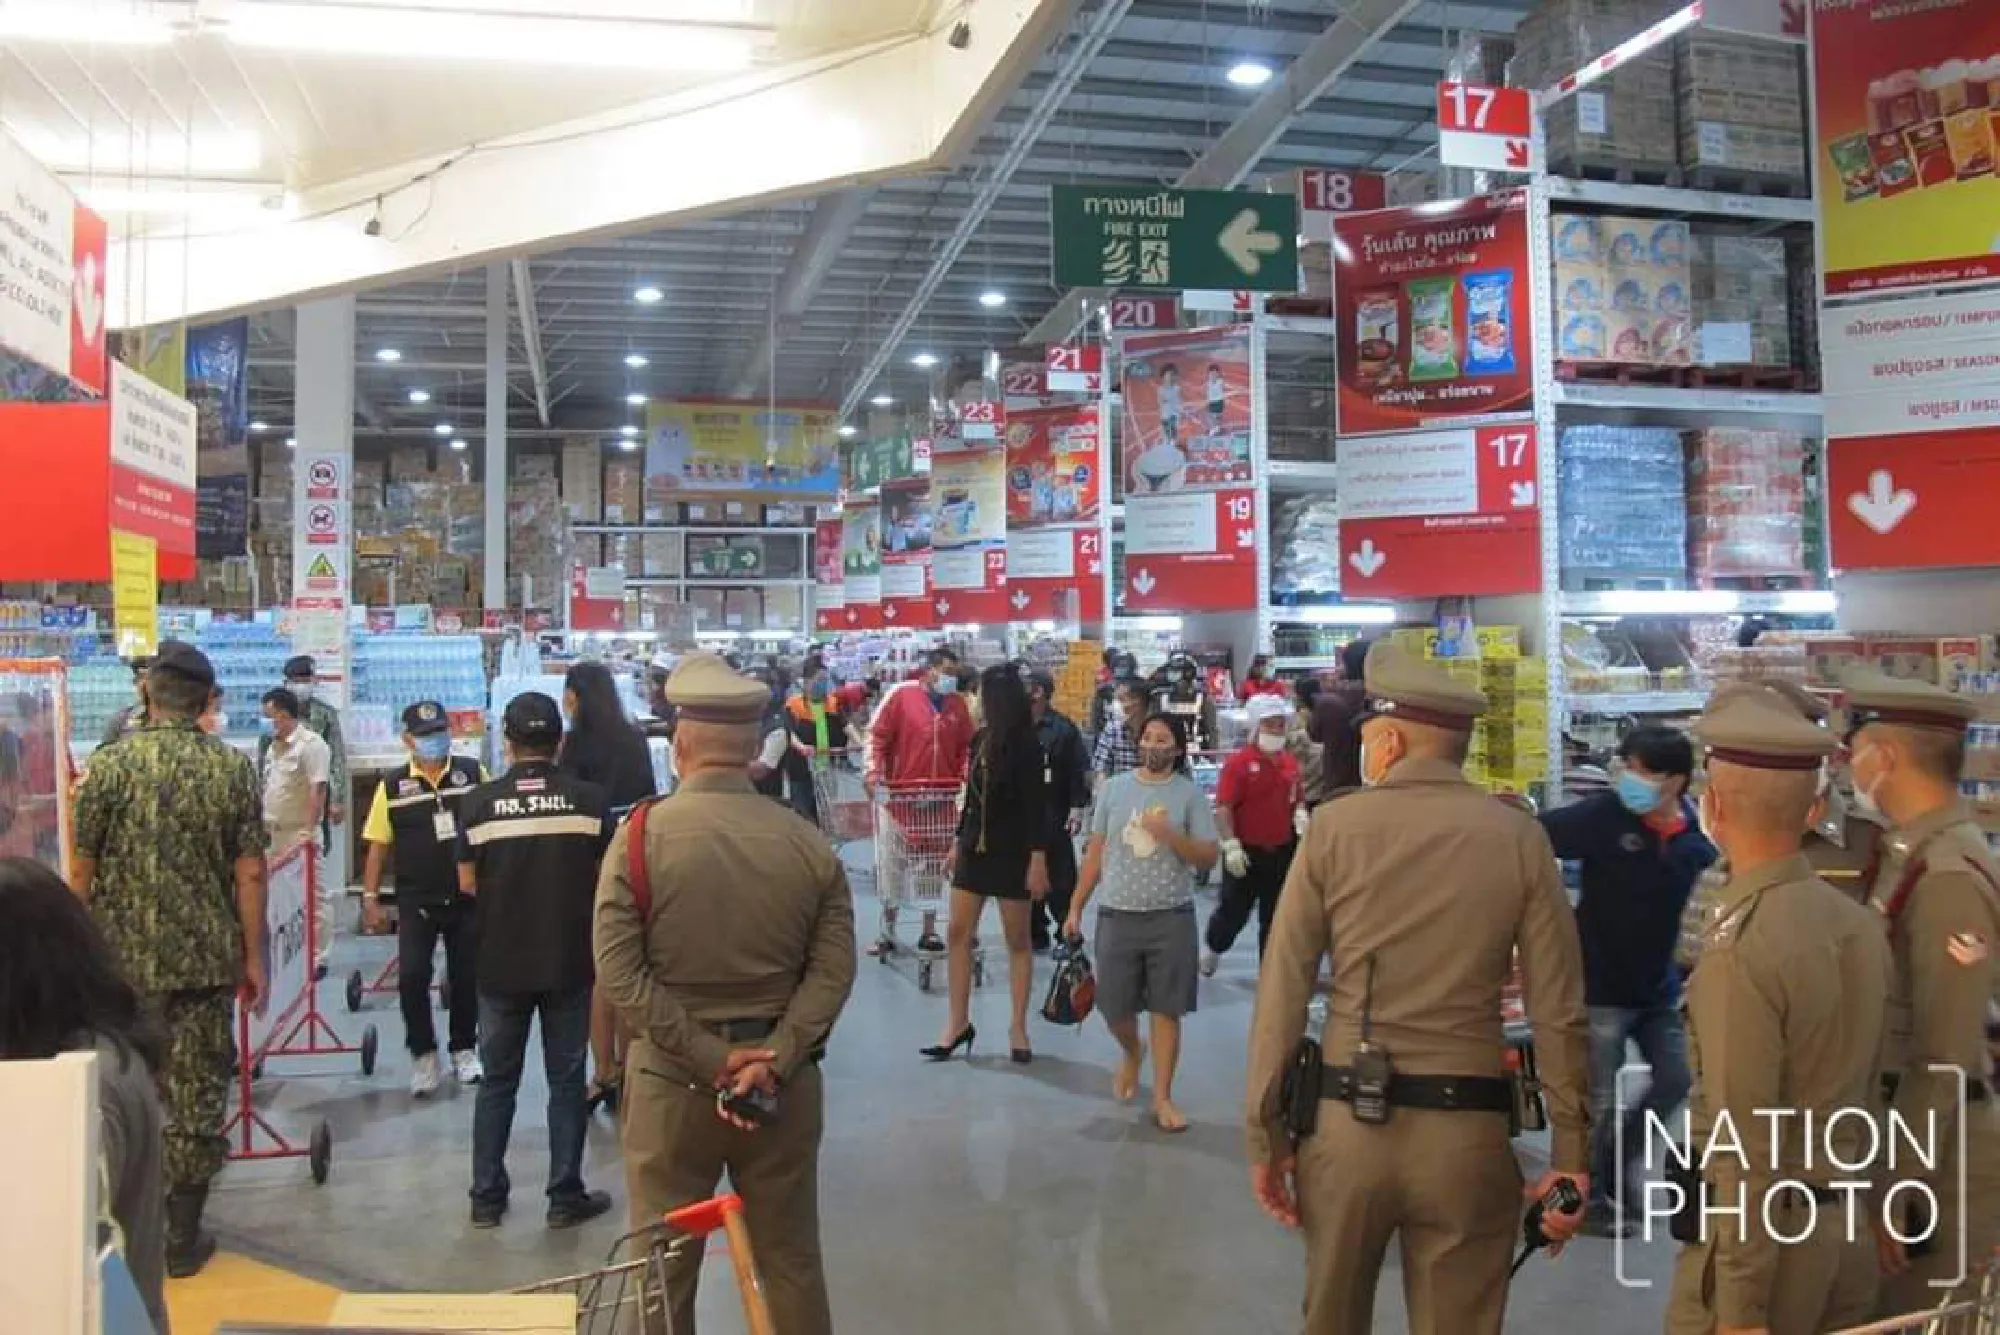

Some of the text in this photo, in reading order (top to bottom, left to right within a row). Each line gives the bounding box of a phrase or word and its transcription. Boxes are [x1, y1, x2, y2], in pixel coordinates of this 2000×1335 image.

[1444, 86, 1496, 128] 17
[1306, 172, 1352, 209] 18
[1082, 192, 1185, 218] ทางหนีไฟ
[1103, 221, 1169, 238] FIRE EXIT
[1113, 301, 1156, 327] 20
[1050, 347, 1081, 370] 21
[1006, 374, 1038, 393] 22
[965, 401, 994, 420] 23
[1488, 433, 1527, 468] 17
[1225, 497, 1250, 520] 19
[1080, 535, 1098, 554] 21
